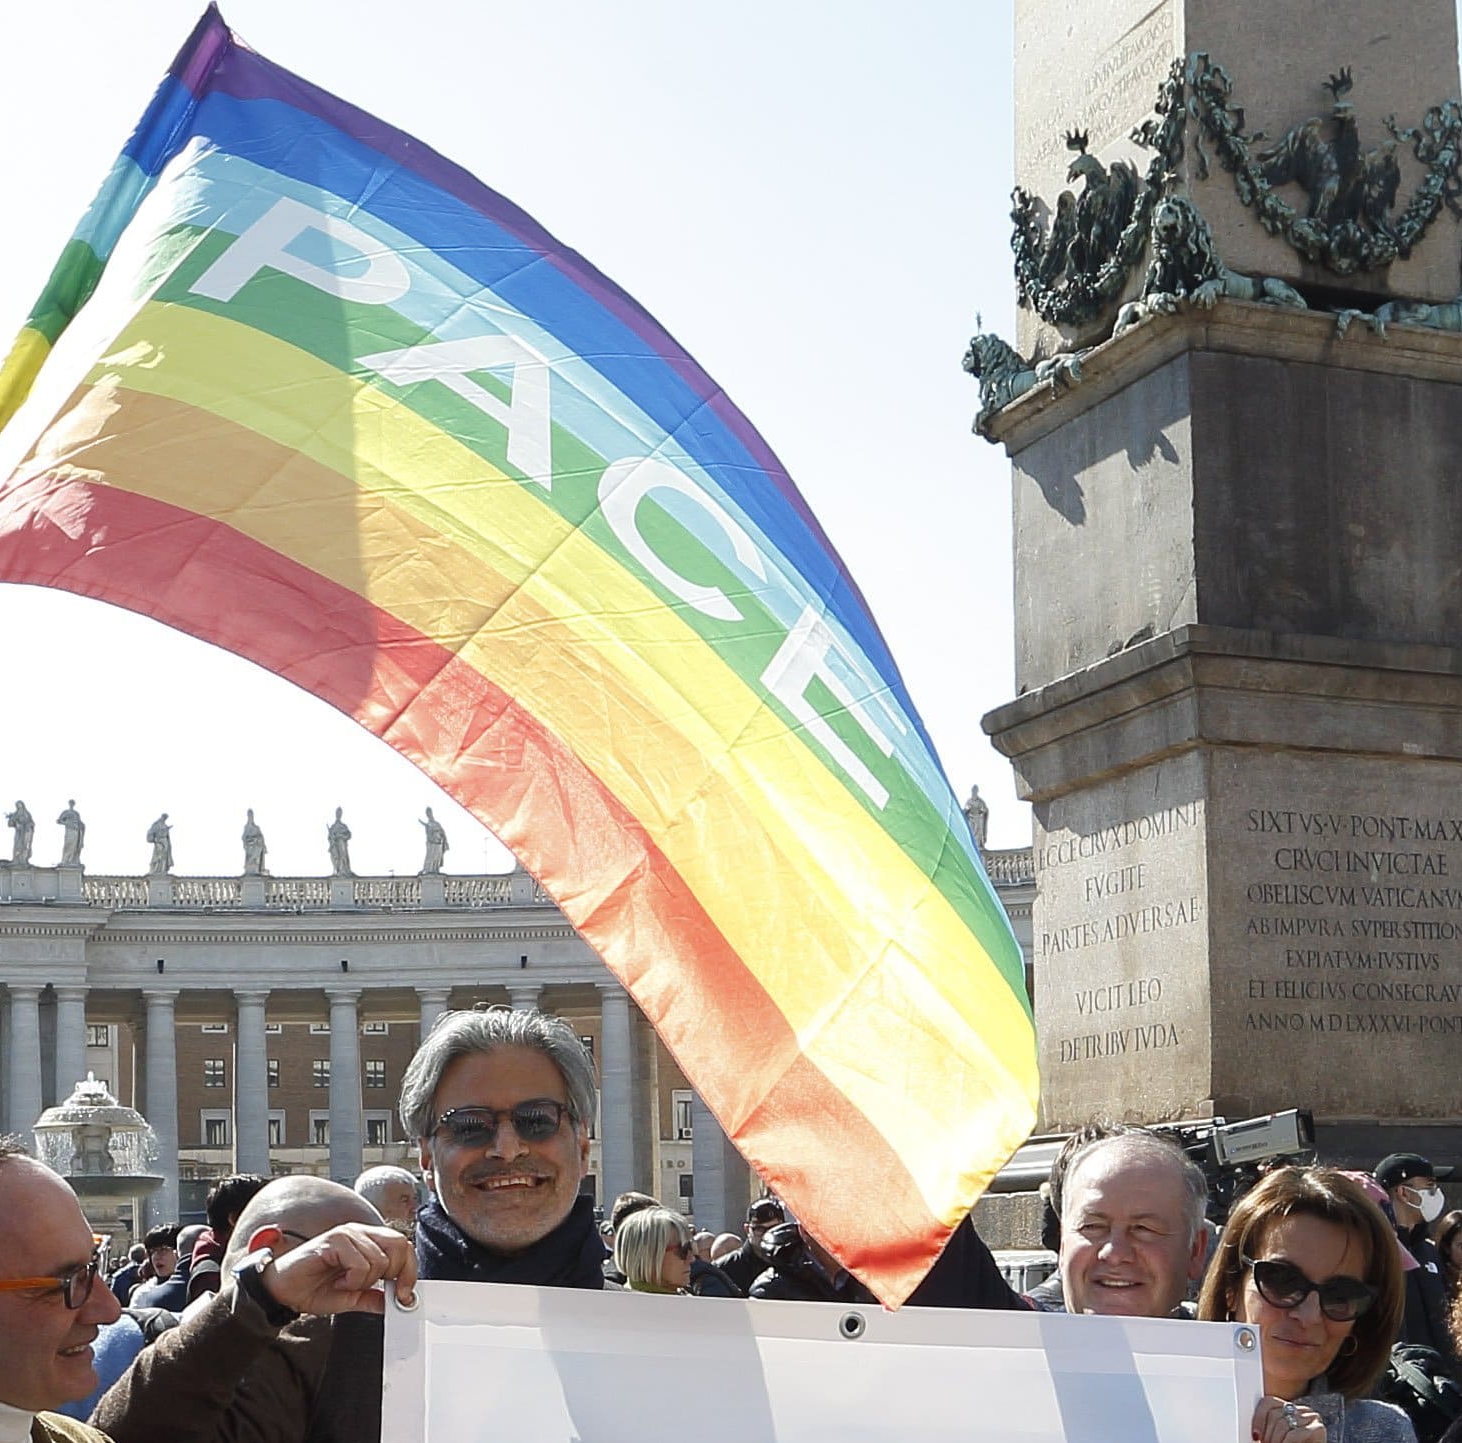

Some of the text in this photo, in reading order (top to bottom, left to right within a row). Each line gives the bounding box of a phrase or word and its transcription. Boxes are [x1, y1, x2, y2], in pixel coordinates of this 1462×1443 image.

[188, 196, 907, 811] PACE
[1085, 863, 1147, 902] FVGITE
[1346, 851, 1450, 876] INVICTAE
[1247, 883, 1356, 906] OBELISCVM
[1075, 977, 1163, 1015] VICIT LEO
